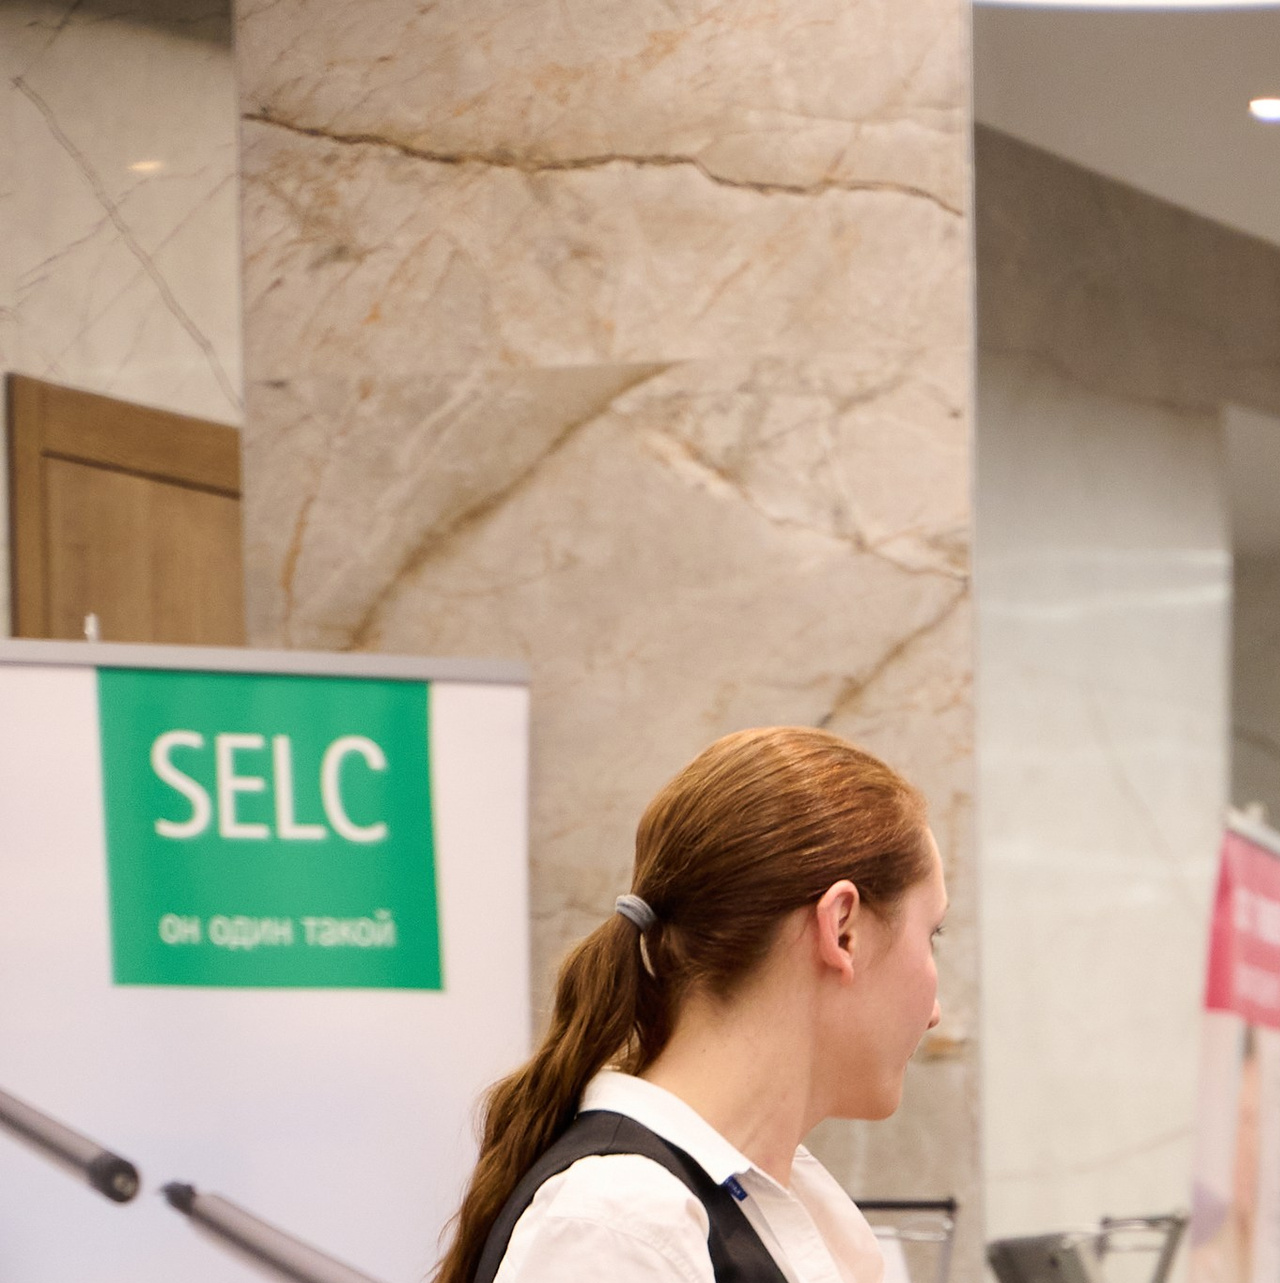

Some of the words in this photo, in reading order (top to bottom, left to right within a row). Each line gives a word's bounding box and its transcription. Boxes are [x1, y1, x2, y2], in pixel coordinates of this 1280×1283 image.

[150, 729, 389, 844] SELC
[159, 913, 201, 945] он
[207, 915, 293, 949] один
[302, 908, 397, 948] такой
